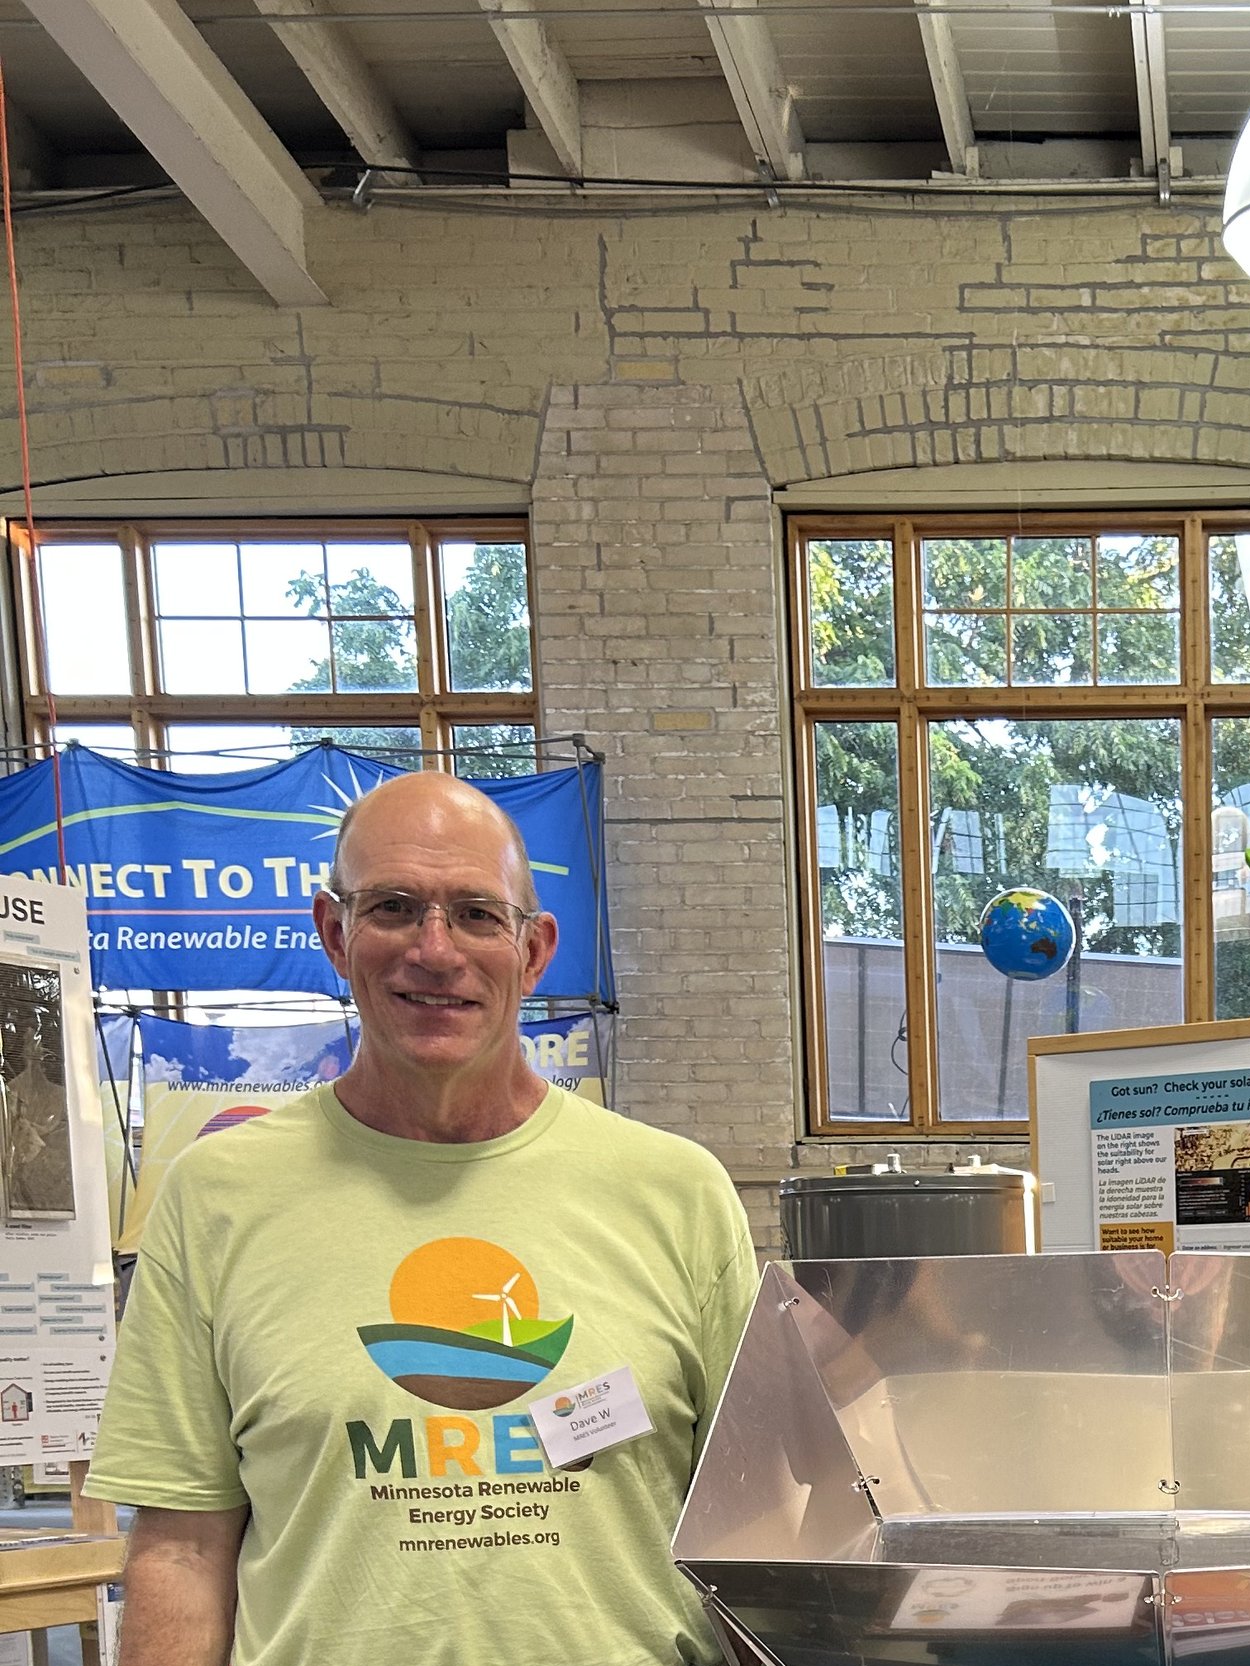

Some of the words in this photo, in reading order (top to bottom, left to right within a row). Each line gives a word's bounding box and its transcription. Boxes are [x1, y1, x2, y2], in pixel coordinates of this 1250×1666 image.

[263, 857, 334, 897] TH
[117, 926, 267, 950] Renewable
[274, 926, 323, 950] Ene
[1111, 1086, 1131, 1097] Got
[1133, 1083, 1158, 1095] sun?
[1164, 1079, 1199, 1093] Check
[1201, 1080, 1227, 1093] your
[1097, 1109, 1137, 1123] ¿Tienes
[1139, 1106, 1161, 1118] sol?
[1164, 1103, 1229, 1118] Comprueba
[1232, 1101, 1244, 1111] tu
[1120, 1140, 1137, 1150] right
[1133, 1132, 1154, 1140] image
[578, 1382, 611, 1400] MRES
[570, 1415, 598, 1431] Dave
[598, 1408, 611, 1420] W
[346, 1414, 594, 1479] MRE
[370, 1485, 473, 1500] Minnesota
[478, 1478, 581, 1496] Renewable
[409, 1508, 476, 1526] Energy
[480, 1503, 549, 1521] Society
[399, 1531, 560, 1552] mnrenewables.org
